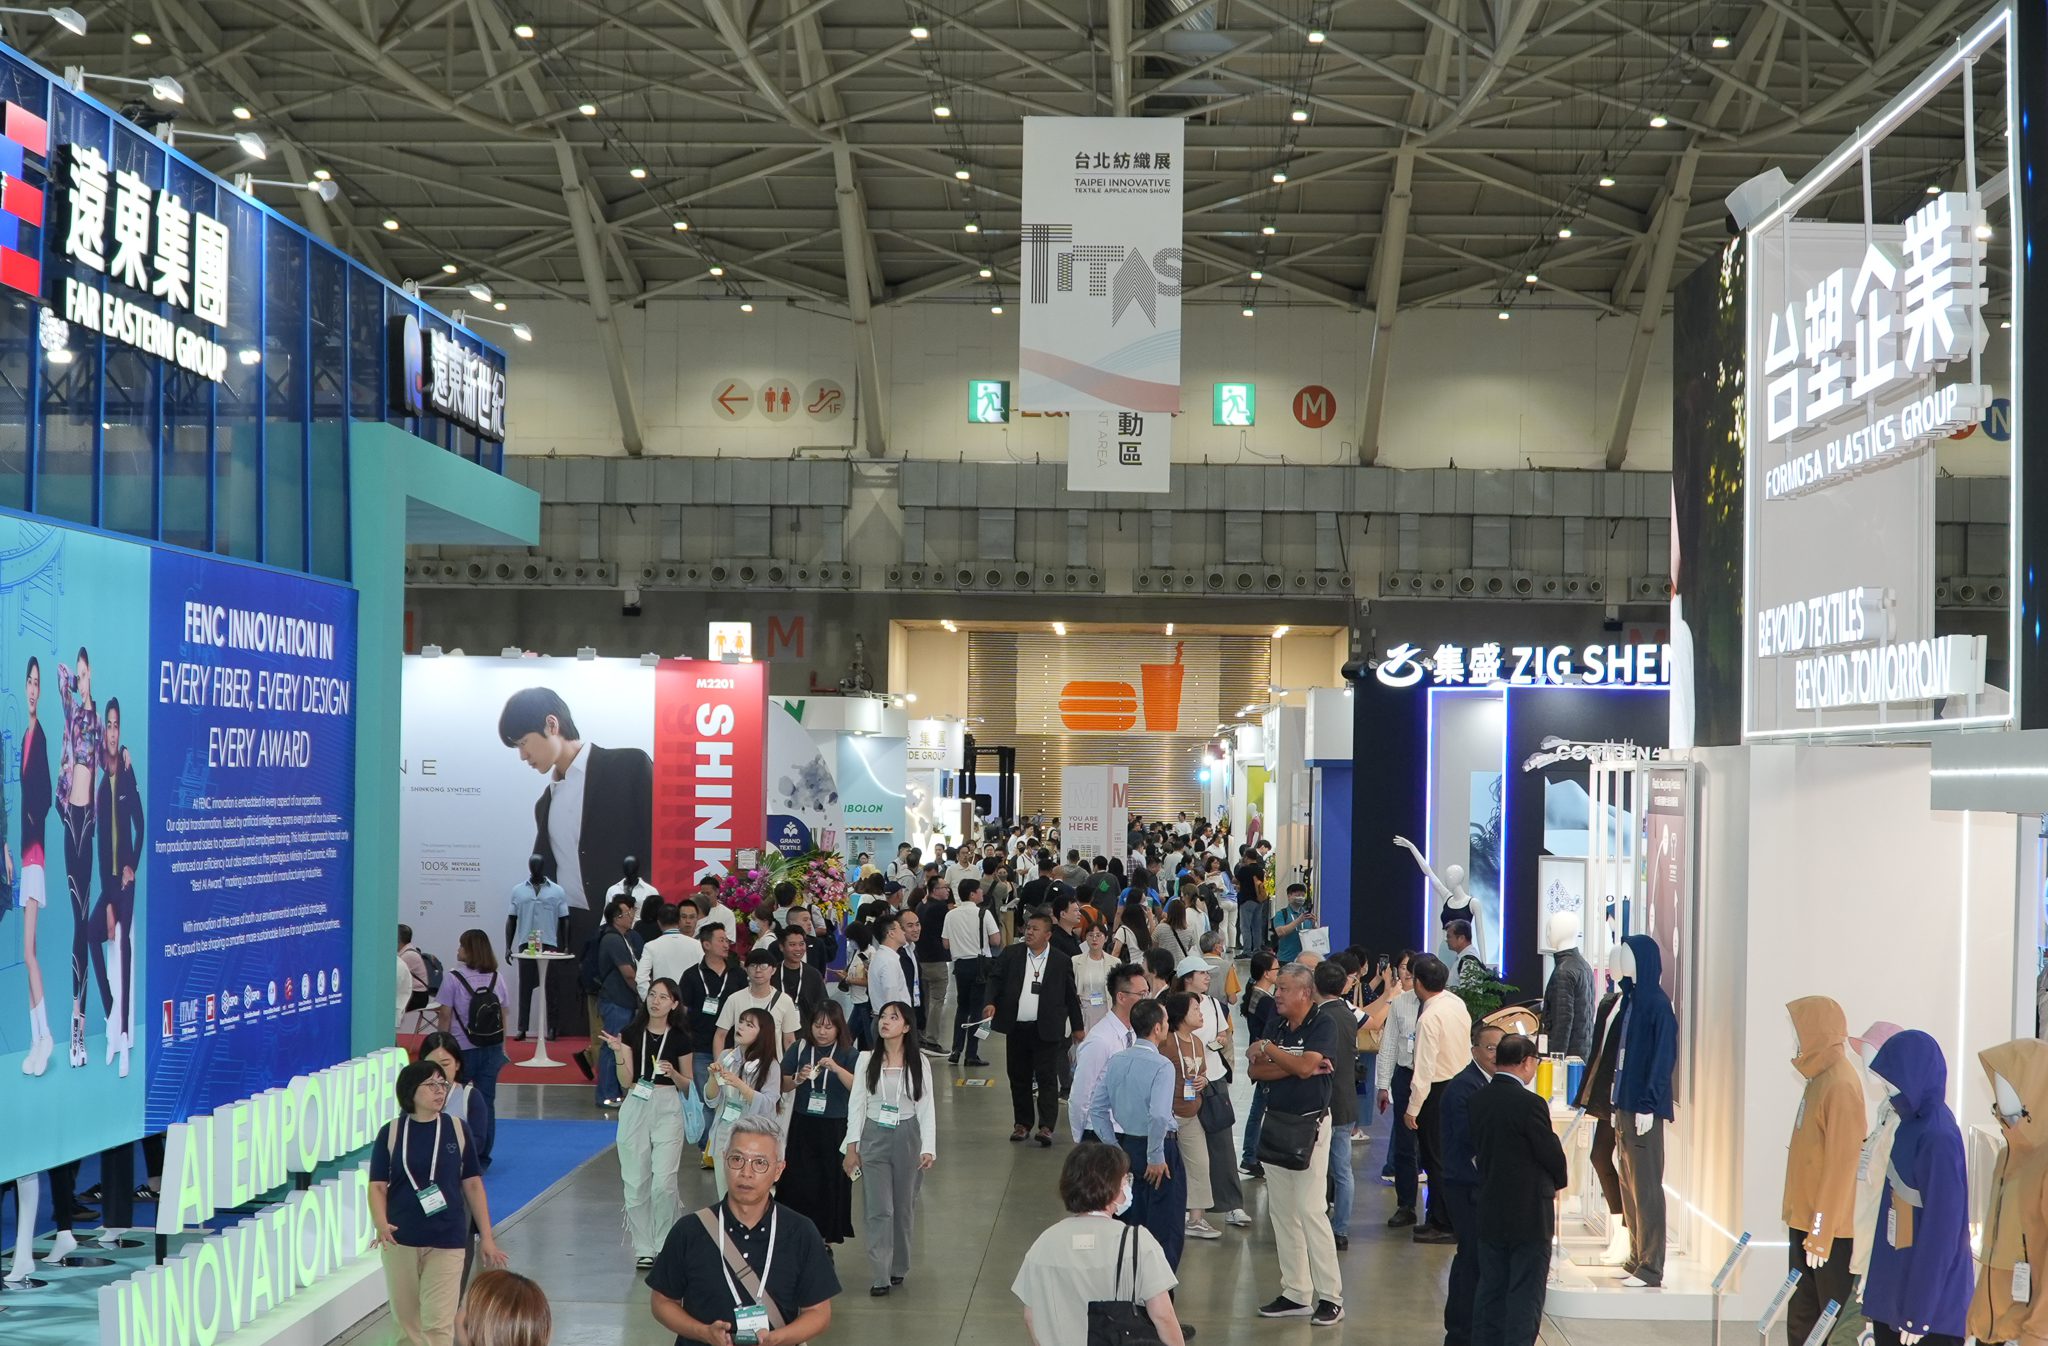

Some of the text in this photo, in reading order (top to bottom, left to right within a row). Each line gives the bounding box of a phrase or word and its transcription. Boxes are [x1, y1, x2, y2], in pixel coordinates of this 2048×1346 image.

[1075, 152, 1170, 169] 台北紡織展
[1075, 179, 1170, 187] TAIPEI INNOVATIVE
[66, 142, 230, 328] 遠東集團
[66, 276, 228, 384] FAR EASTERN GROUP
[1765, 192, 1956, 442] 台塑企業
[431, 328, 506, 438] 遠東新世紀
[829, 404, 841, 413] 1F
[1302, 393, 1326, 420] M
[1765, 383, 1957, 500] FORMOSA PLASTICS GROUP
[184, 601, 334, 660] FENC INNOVATION IN
[1758, 586, 1865, 658] BEYOND TEXTILES
[159, 660, 349, 715] EVERY FIBER, EVERY DESIGN
[696, 679, 735, 689] M2201
[1433, 643, 1501, 684] 集盛
[1511, 645, 1572, 685] ZIG
[1795, 636, 1952, 709] BEYOND TOMORROW
[208, 727, 311, 767] EVERY AWARD
[1069, 823, 1098, 831] HERE
[421, 861, 448, 871] 100%
[175, 1114, 214, 1234] AI
[117, 1186, 343, 1346] INNOVATION
